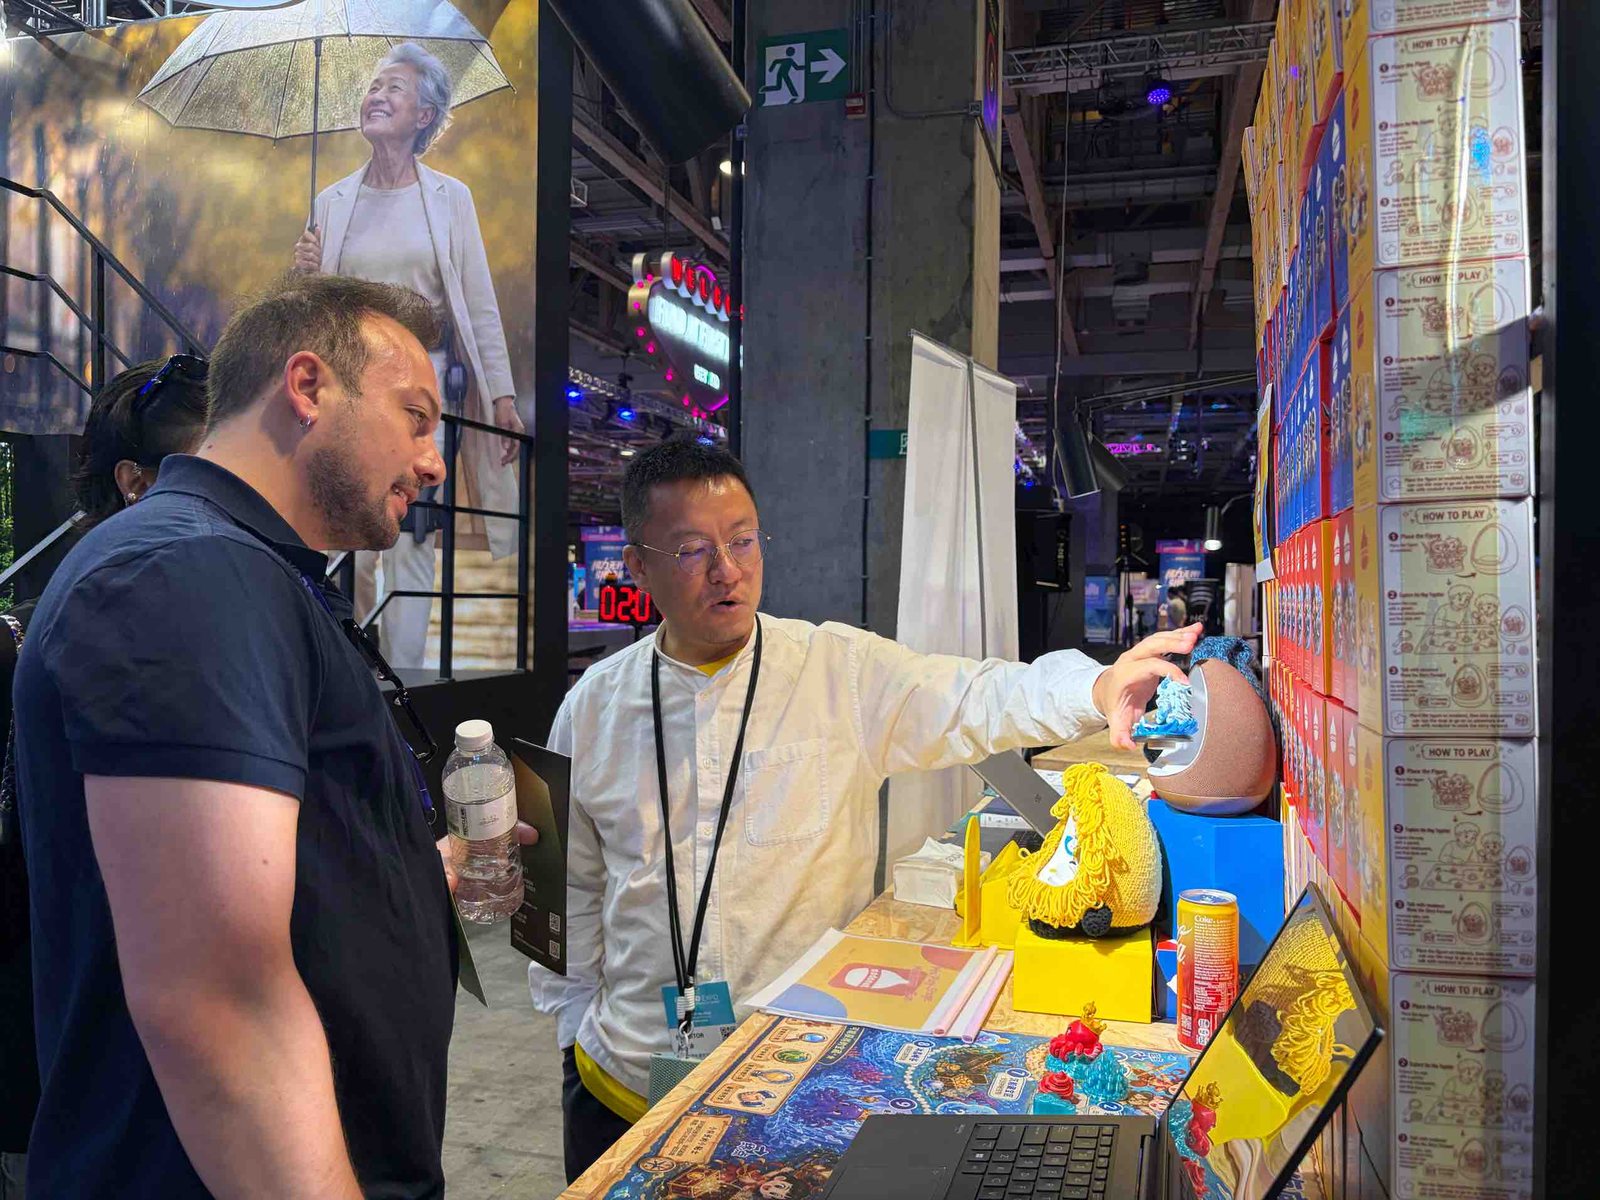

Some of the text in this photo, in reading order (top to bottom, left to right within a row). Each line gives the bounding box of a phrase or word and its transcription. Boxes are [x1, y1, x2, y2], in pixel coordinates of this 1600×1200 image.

[1412, 36, 1472, 48] HOW TO PLA
[1419, 275, 1440, 284] HOW
[1458, 271, 1480, 280] PLAY
[1422, 510, 1484, 521] HOW TO PLAY
[1429, 748, 1490, 758] HOW TO PLAY
[1434, 984, 1495, 996] HOW TO PLAY
